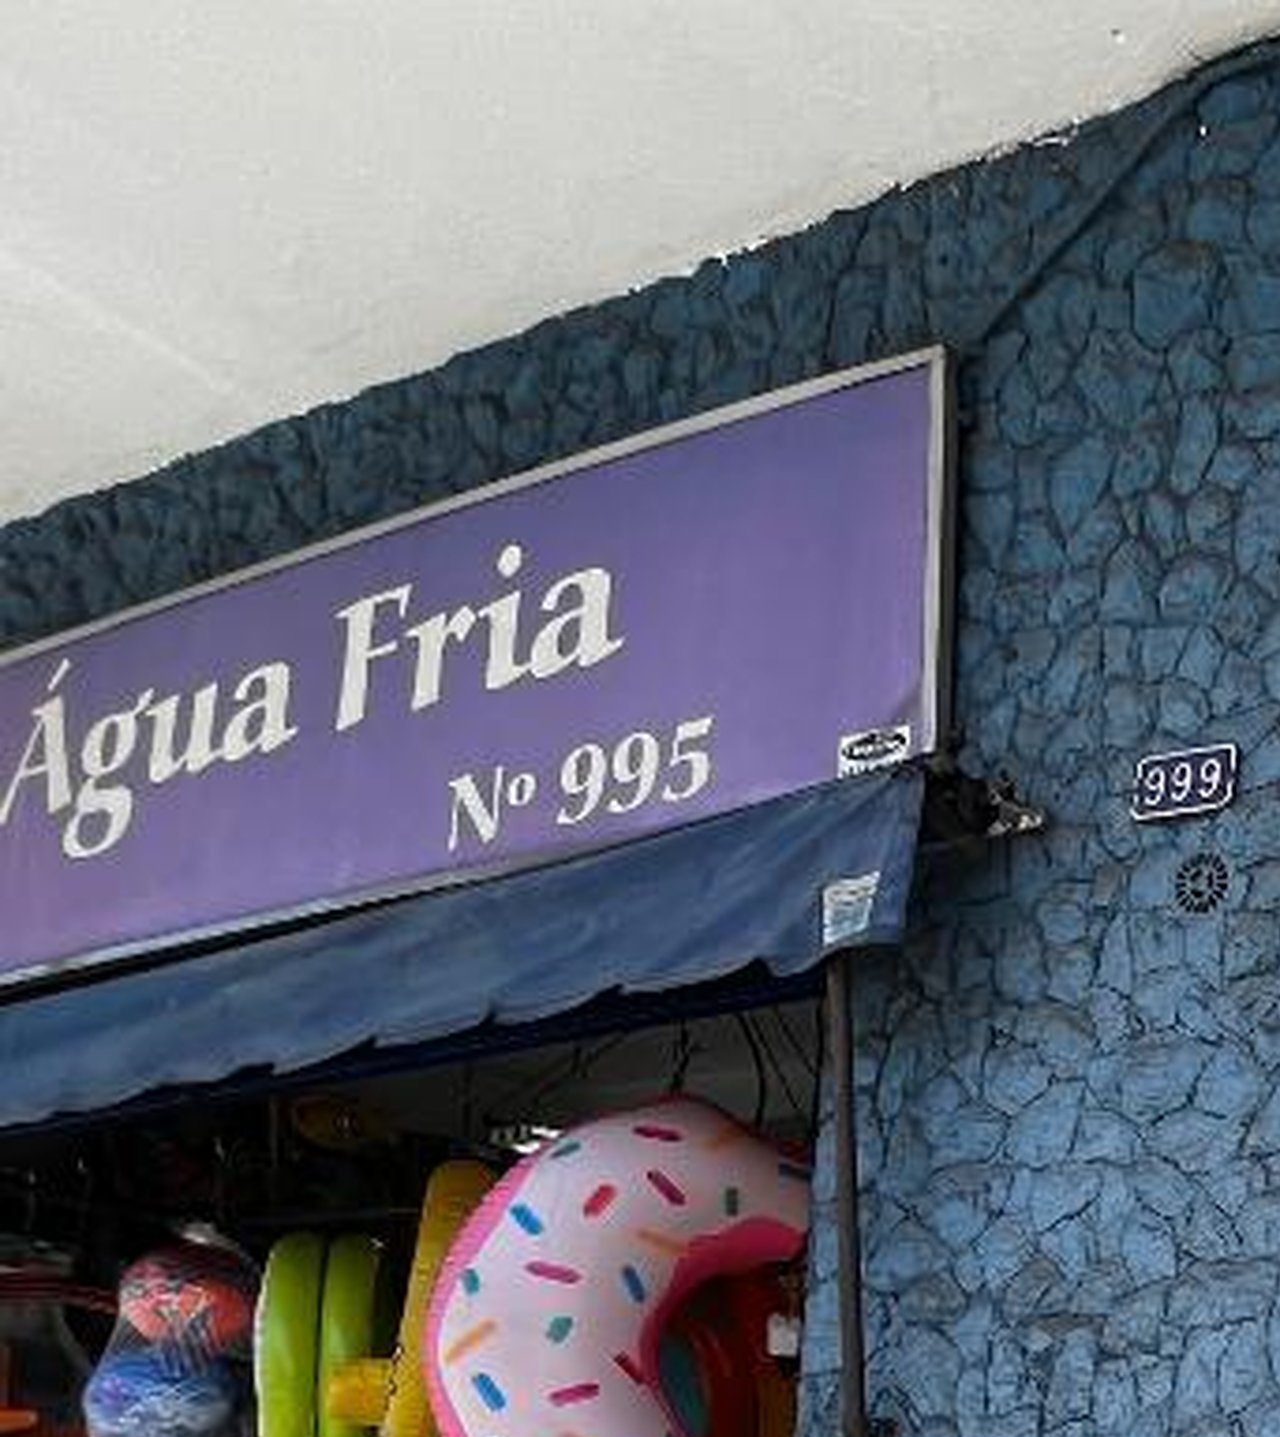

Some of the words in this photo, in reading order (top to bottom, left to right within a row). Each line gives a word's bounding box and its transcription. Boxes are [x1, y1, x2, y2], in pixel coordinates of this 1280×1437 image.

[0, 658, 298, 858] Água
[335, 544, 625, 731] Fria
[556, 716, 713, 824] 995
[1144, 758, 1221, 806] 999
